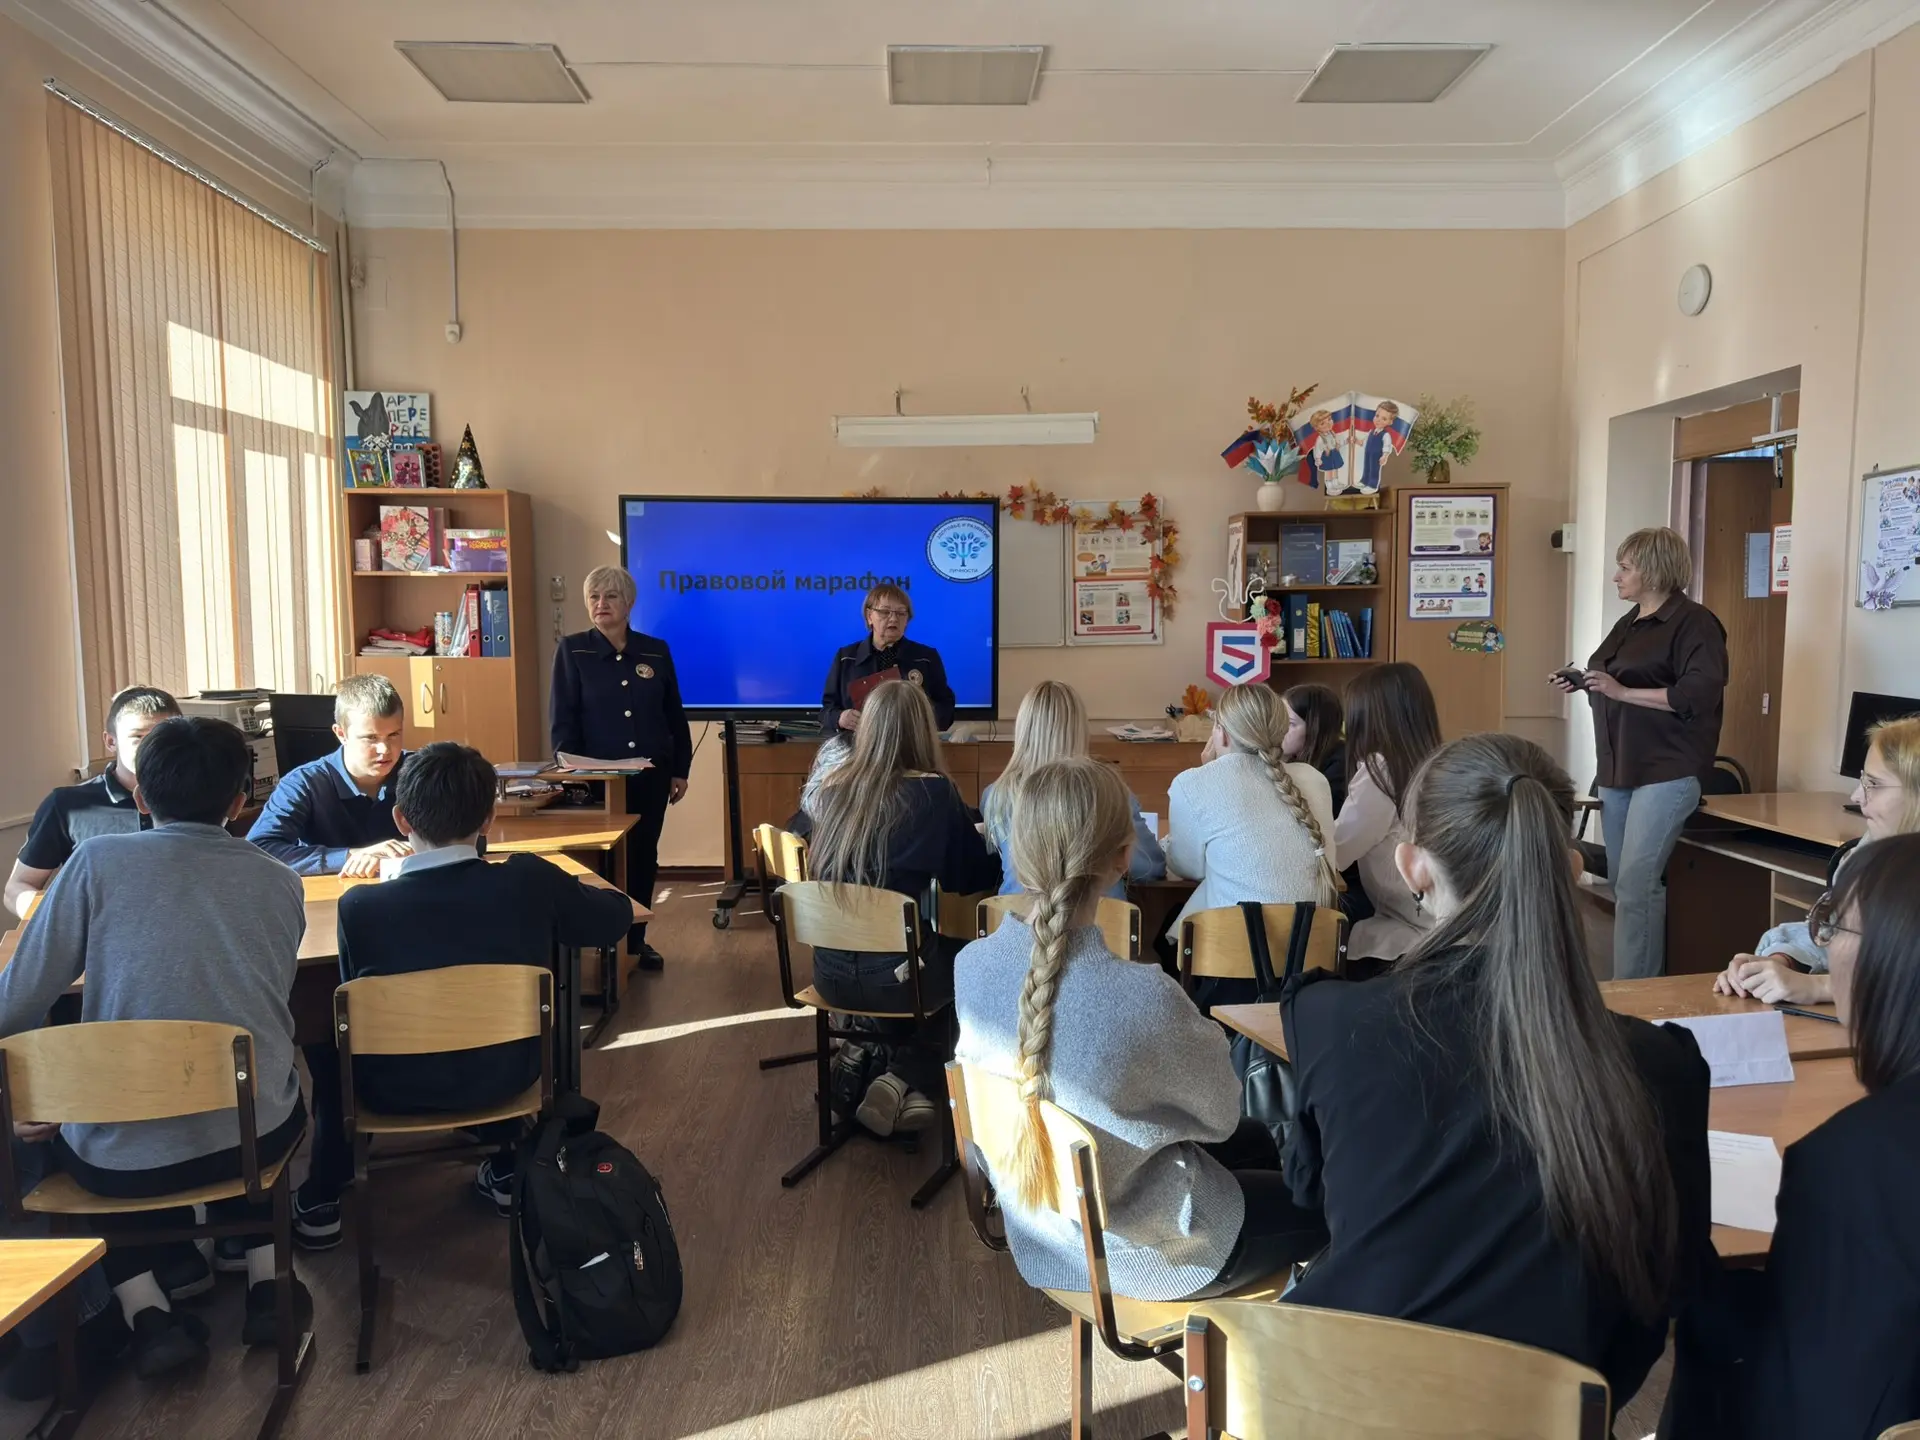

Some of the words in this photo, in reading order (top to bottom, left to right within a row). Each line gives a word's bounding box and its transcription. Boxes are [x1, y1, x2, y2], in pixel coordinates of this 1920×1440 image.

[386, 395, 417, 409] АРТ
[388, 407, 427, 424] ПЕРЕ
[659, 569, 786, 595] Правовой
[795, 570, 910, 596] марафон
